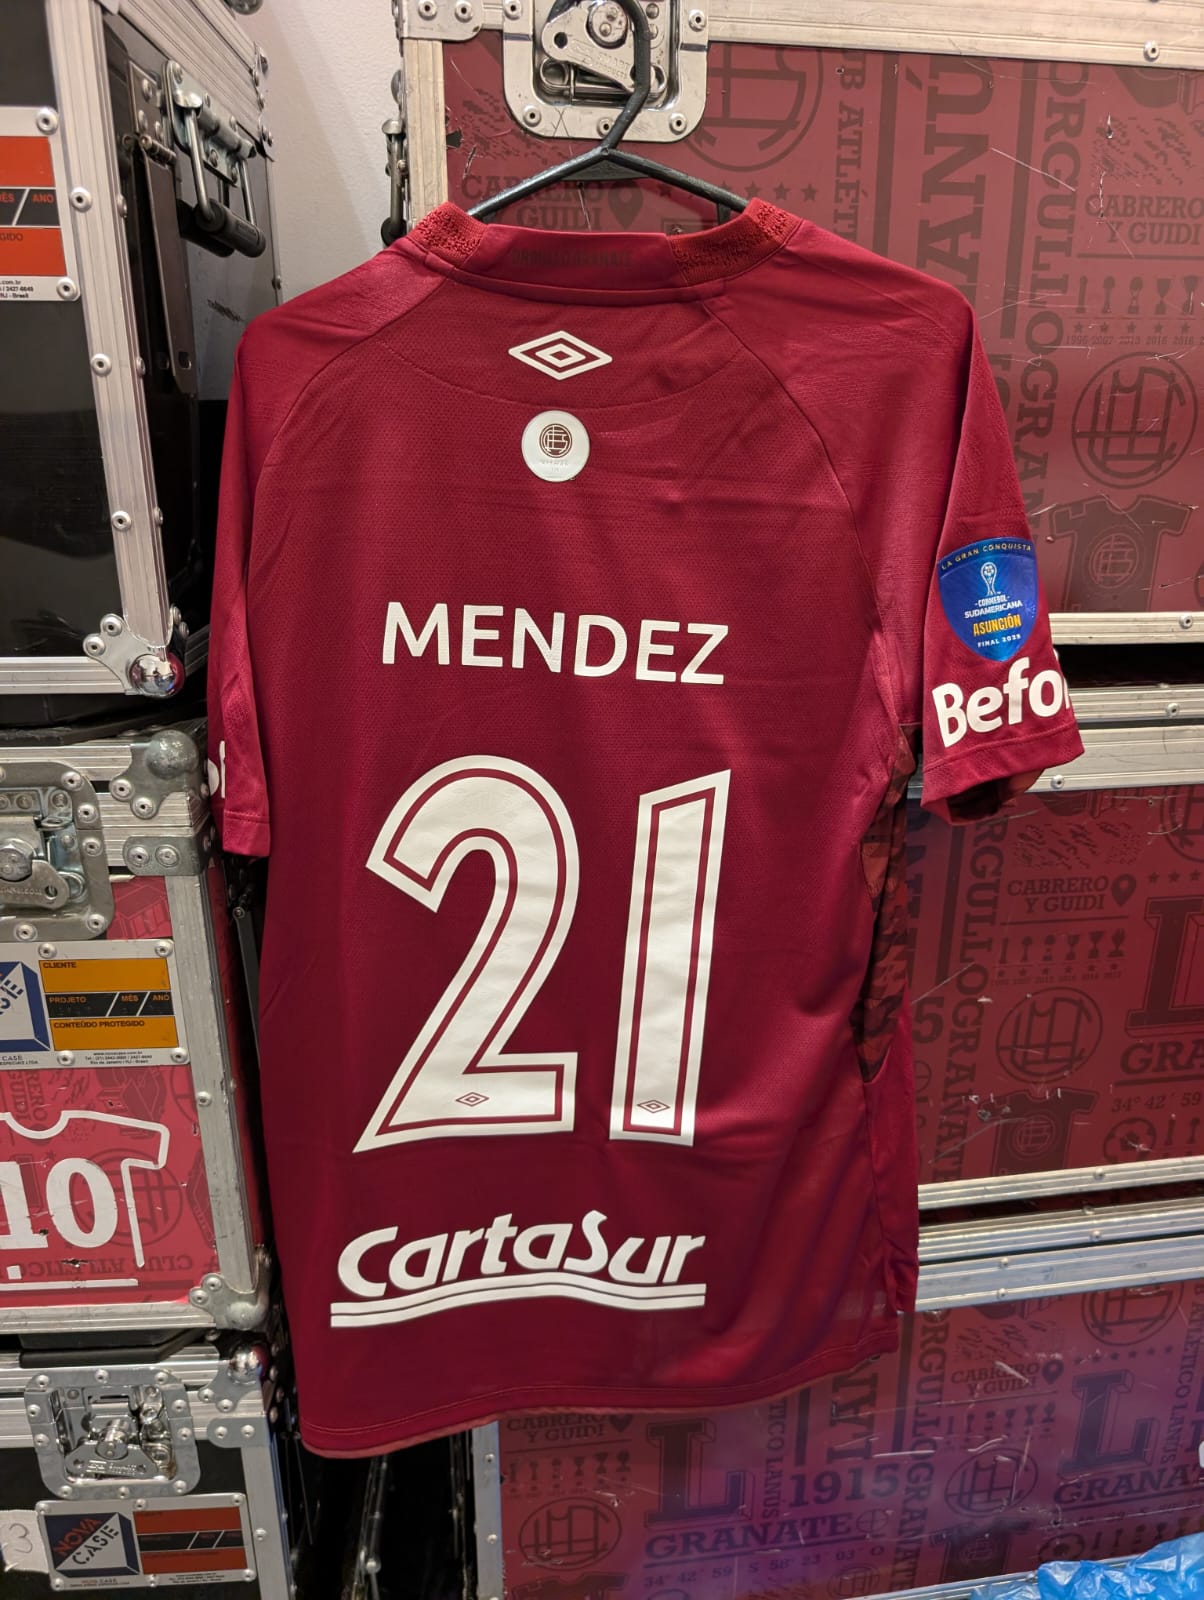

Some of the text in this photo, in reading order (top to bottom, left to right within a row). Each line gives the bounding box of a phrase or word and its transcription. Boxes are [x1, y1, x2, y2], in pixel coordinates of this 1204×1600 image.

[32, 194, 54, 203] ANO
[1107, 220, 1202, 246] Y GUIDI
[955, 548, 980, 562] GRAN
[982, 543, 1032, 553] CONQUISTA
[964, 599, 1024, 619] SUDAMERICANA
[972, 613, 1022, 638] ASUNCIÓN
[382, 601, 728, 685] MENDEZ
[977, 638, 1000, 648] FINAL
[1007, 874, 1109, 897] CABRERO
[1026, 893, 1106, 914] Y GUIDI
[43, 961, 77, 969] CLIENTE
[352, 754, 731, 1153] 21
[337, 1209, 707, 1297] CartaSur
[789, 1464, 901, 1509] 1915
[52, 1517, 101, 1555] NOVA
[72, 1525, 119, 1565] CASE
[644, 1512, 854, 1559] GRANATE
